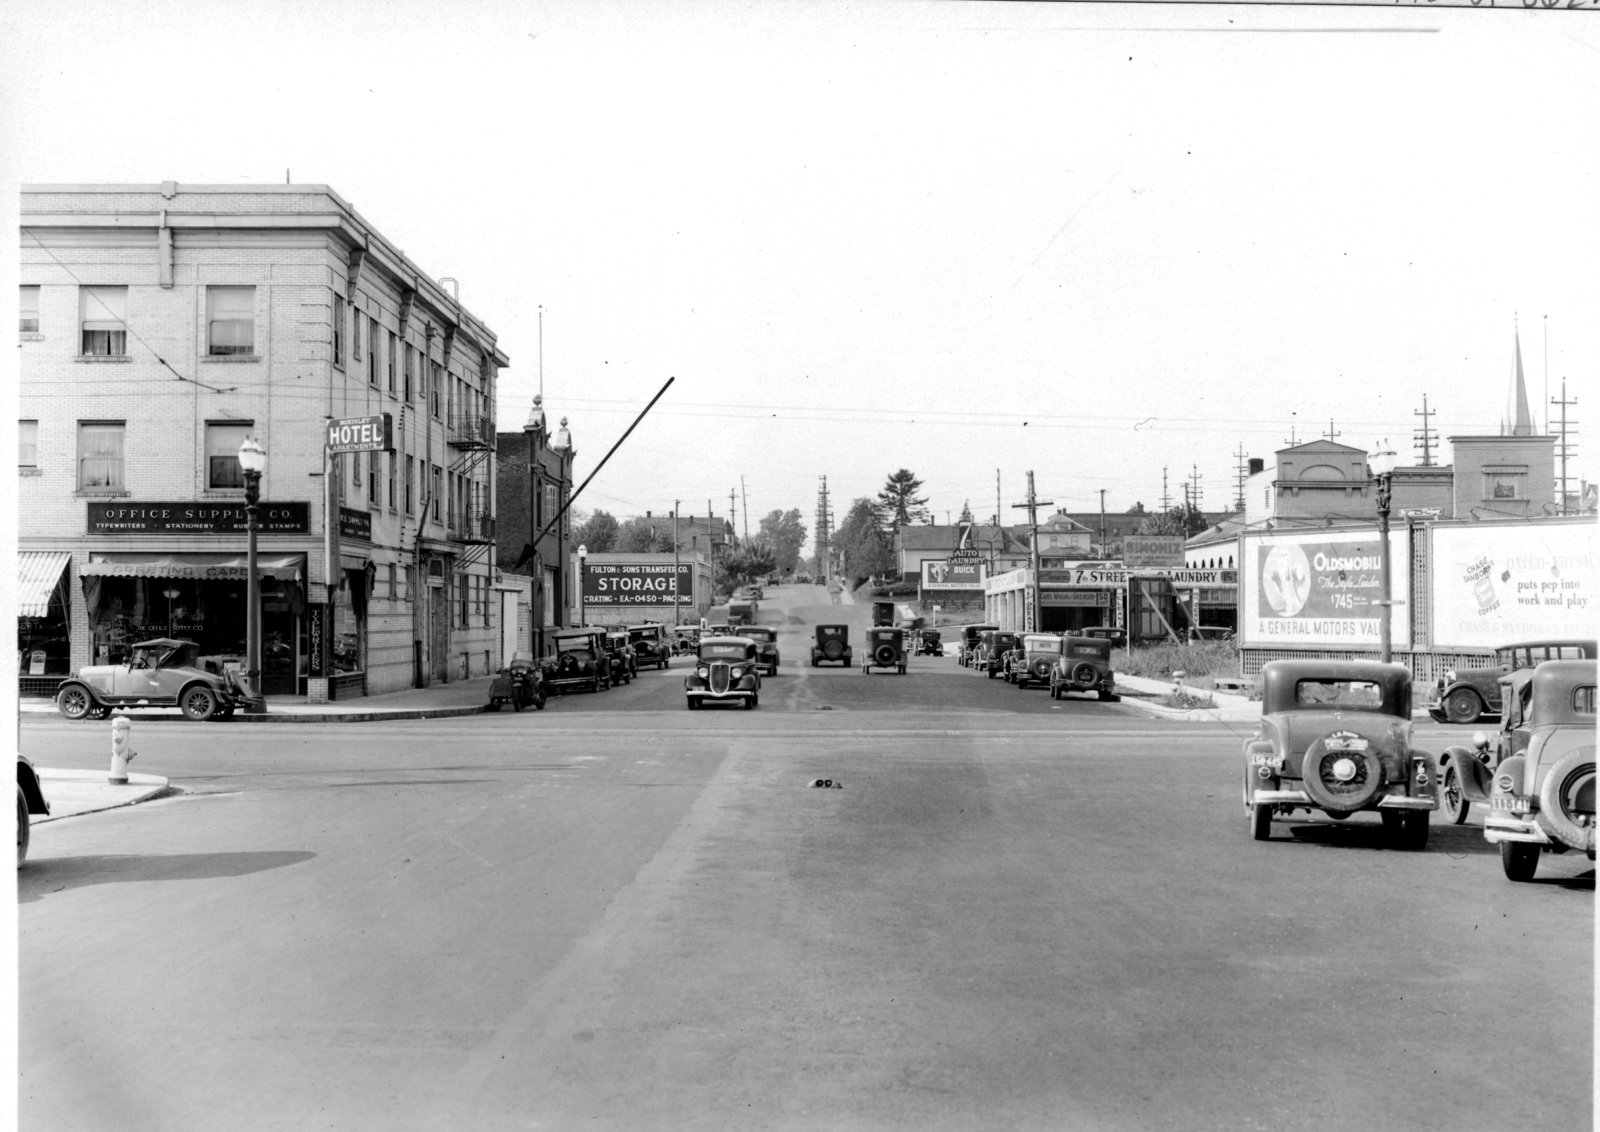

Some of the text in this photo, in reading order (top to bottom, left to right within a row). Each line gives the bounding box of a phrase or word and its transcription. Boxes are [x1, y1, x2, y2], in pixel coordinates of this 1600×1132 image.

[329, 423, 382, 445] HOTEL
[106, 510, 171, 519] OFFICE
[185, 510, 244, 519] SUPPL
[1126, 541, 1182, 554] SIMONIZ
[113, 565, 193, 576] GREETING
[678, 565, 689, 573] CO.
[953, 566, 975, 574] BUICK
[1467, 556, 1488, 574] CHASE
[1090, 570, 1133, 582] STREE
[1317, 575, 1335, 589] The
[598, 577, 677, 591] STORAGE
[1517, 578, 1581, 593] puts pep into
[584, 595, 613, 603] CRATING
[662, 595, 692, 603] PACING
[1098, 592, 1108, 600] 50
[1517, 593, 1588, 609] work and play
[1478, 599, 1501, 616] COFFEE
[1259, 621, 1379, 635] A GENERAL MOTORS VAL
